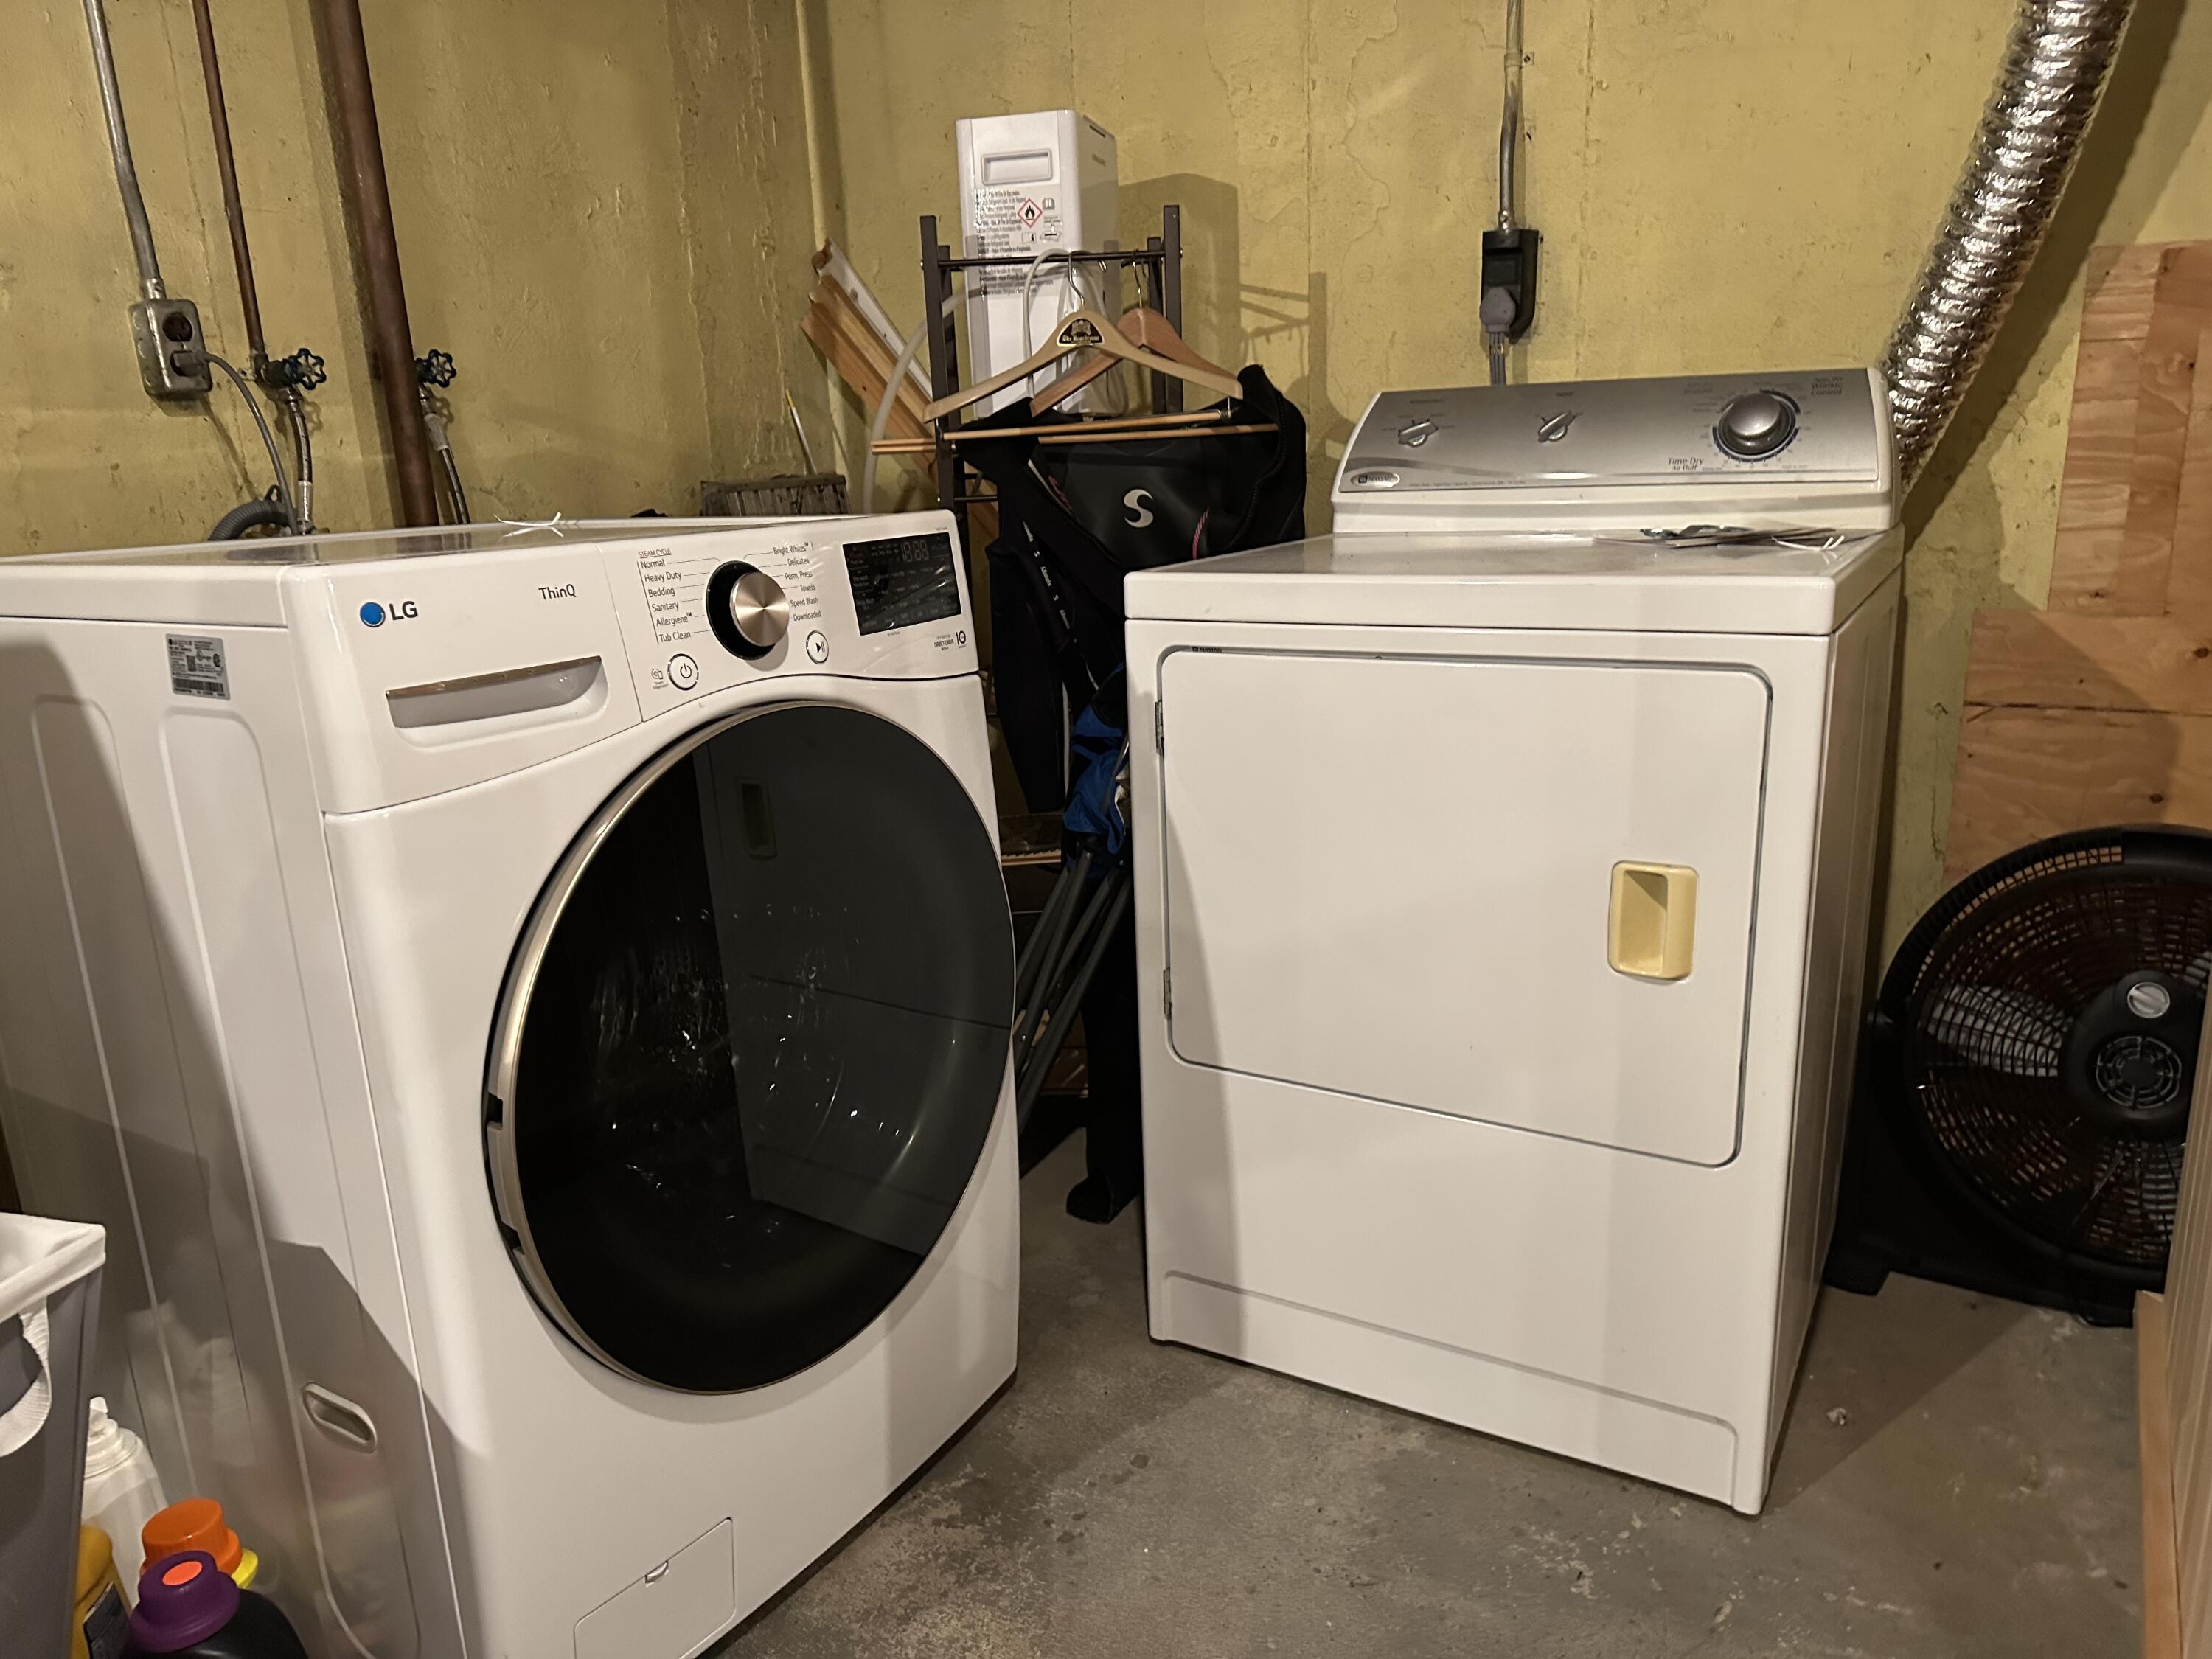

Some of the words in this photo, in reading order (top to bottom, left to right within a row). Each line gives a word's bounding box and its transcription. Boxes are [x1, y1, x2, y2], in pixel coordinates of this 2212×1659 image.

[1668, 456, 1688, 465] Time
[1689, 456, 1704, 466] Dry
[638, 549, 655, 557] STEAM
[655, 547, 672, 556] CYCLE
[773, 546, 790, 557] Bright
[640, 558, 666, 569] Normal
[787, 557, 810, 566] Delicates
[644, 574, 665, 583] Heavy
[665, 571, 682, 581] Duty
[799, 570, 813, 579] Press
[538, 583, 577, 601] ThinQ
[648, 585, 675, 598] Bedding
[799, 582, 816, 592] Towels
[651, 602, 679, 613] Sanitary
[790, 597, 806, 608] Speed
[805, 596, 819, 605] Wash
[389, 600, 419, 621] LG
[793, 609, 822, 622] Downloaded
[658, 633, 672, 643] Tub
[672, 630, 692, 641] Clean
[956, 630, 967, 645] 10
